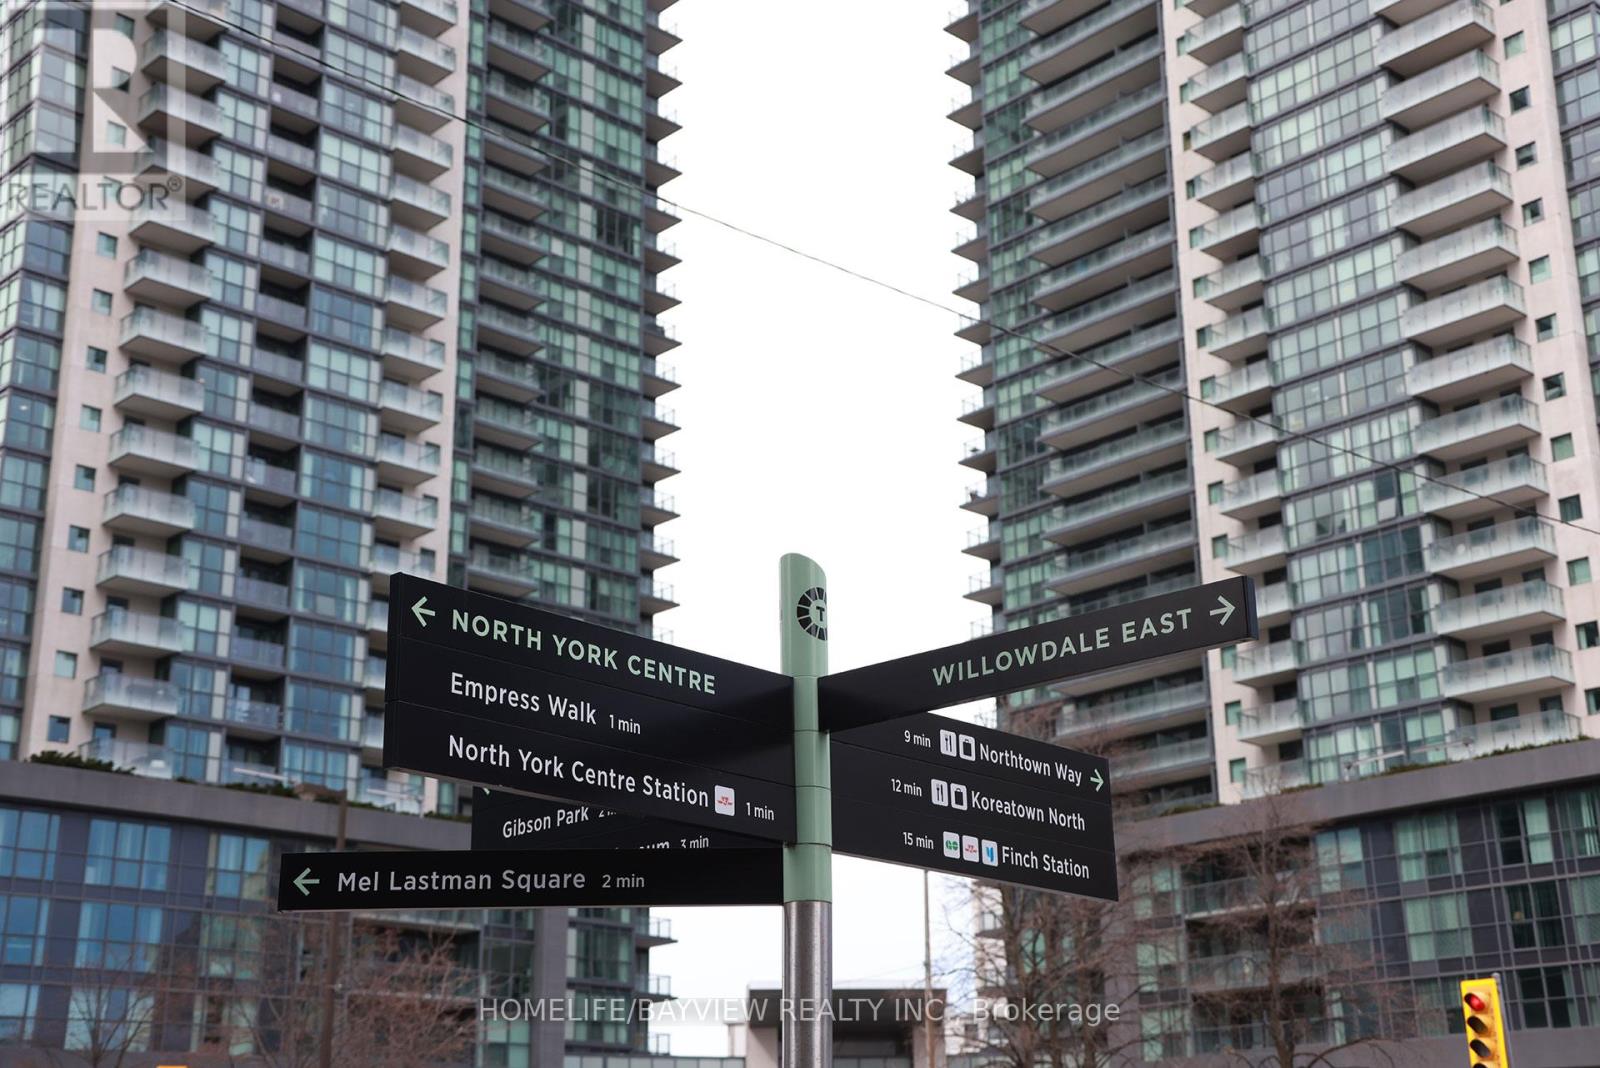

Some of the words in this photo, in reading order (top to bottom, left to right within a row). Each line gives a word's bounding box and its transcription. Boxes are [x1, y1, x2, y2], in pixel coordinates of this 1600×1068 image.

[451, 608, 542, 651] NORTH
[552, 634, 618, 671] YORK
[627, 654, 716, 695] CENTRE
[932, 626, 1111, 686] WILLOWDALE
[1121, 607, 1192, 644] EAST
[450, 671, 540, 713] Empress
[547, 693, 597, 725] Walk
[608, 714, 614, 729] 1
[618, 718, 641, 735] min
[448, 734, 510, 768] North
[518, 748, 564, 779] York
[571, 760, 636, 793] Centre
[642, 774, 709, 808] Station
[746, 801, 751, 817] 1
[754, 805, 775, 821] min
[903, 729, 911, 745] 9
[913, 731, 932, 749] min
[979, 742, 1051, 777] Northtown
[1053, 761, 1082, 787] Way
[502, 814, 551, 839] Gibson
[556, 806, 590, 827] Park
[890, 778, 902, 793] 12
[903, 781, 923, 798] min
[971, 790, 1045, 823] Koreatown
[1048, 807, 1086, 832] North
[689, 835, 709, 850] min
[902, 831, 914, 846] 15
[915, 833, 935, 850] min
[1001, 845, 1039, 870] Finch
[1041, 852, 1090, 880] Station
[336, 871, 380, 893] Mel
[388, 870, 492, 892] Lastman
[500, 869, 586, 893] Square
[602, 874, 611, 888] 2
[616, 873, 645, 888] min
